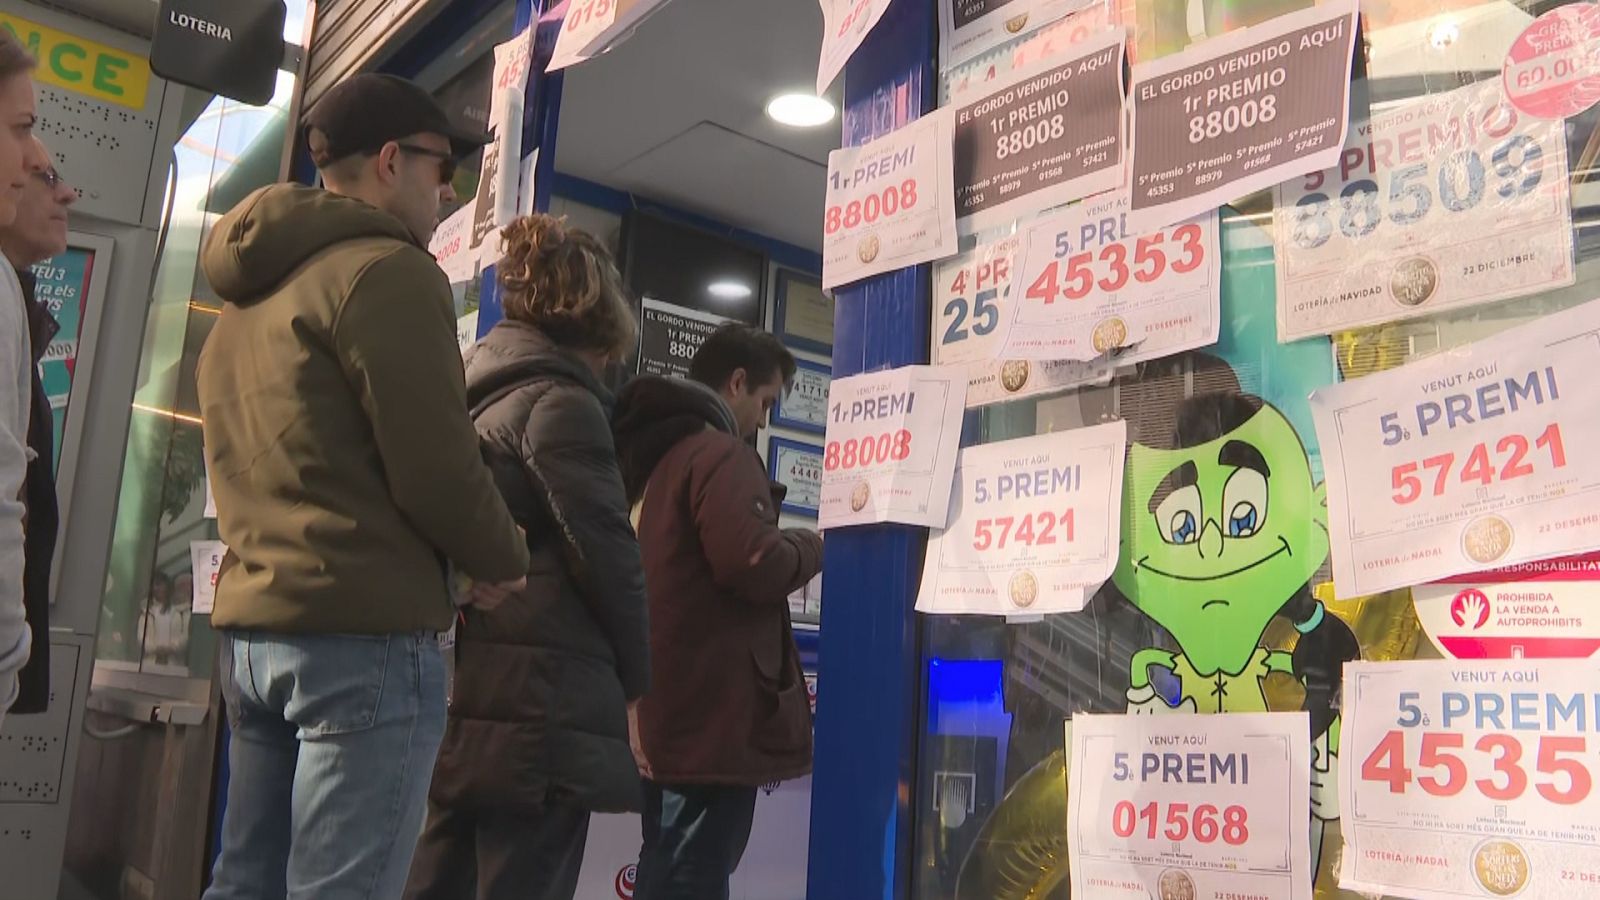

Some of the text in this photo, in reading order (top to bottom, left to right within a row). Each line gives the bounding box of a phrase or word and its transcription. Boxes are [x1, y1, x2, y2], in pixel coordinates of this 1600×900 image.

[170, 10, 232, 41] LOTERIA
[1141, 19, 1344, 101] EL GORDO VENDIDO AQUÍ
[959, 50, 1113, 124] EL GORDO VENDIDO AQUÍ
[1183, 68, 1286, 115] 1r PREMIO
[990, 89, 1069, 135] 1r PREMIO
[1188, 94, 1277, 144] 88008
[996, 114, 1065, 160] 88008
[1150, 166, 1184, 184] Premio
[1198, 152, 1232, 171] Premio
[1248, 136, 1282, 156] Premio
[1300, 117, 1336, 140] Premio
[1341, 102, 1518, 181] PREMIO
[830, 144, 916, 190] 1r PREMI
[1001, 165, 1029, 181] Premio
[1041, 151, 1072, 167] Premio
[1085, 135, 1116, 153] Premio
[825, 179, 918, 235] 88008
[1147, 183, 1175, 197] 45353
[1292, 134, 1544, 249] 88509
[55, 268, 66, 281] 3
[1025, 223, 1205, 305] 45353
[1463, 253, 1536, 276] 22 DICIEMBRE
[54, 284, 76, 298] els
[1340, 285, 1382, 302] NAVIDAD
[657, 312, 685, 327] GORDO
[942, 284, 1011, 346] 25
[669, 340, 699, 359] 880
[794, 382, 829, 399] 41710
[1421, 362, 1499, 394] VENUT AQUÍ
[832, 392, 915, 423] 1r PREMI
[1416, 366, 1560, 437] PREMI
[824, 428, 912, 471] 88008
[1003, 458, 1029, 469] VENUT
[1391, 422, 1567, 506] 57421
[998, 464, 1081, 501] PREMI
[973, 508, 1075, 551] 57421
[1496, 592, 1554, 602] PROHIBIDA
[1496, 605, 1560, 615] LA VENDA A
[1496, 618, 1583, 627] AUTOPROHIBITS
[1451, 668, 1540, 683] VENUT AQUÍ
[1148, 733, 1208, 746] VENUT AQUÍ
[1141, 752, 1249, 784] PREMI
[1361, 730, 1600, 805] 4535
[1112, 800, 1249, 846] 01568
[1561, 870, 1576, 881] 22
